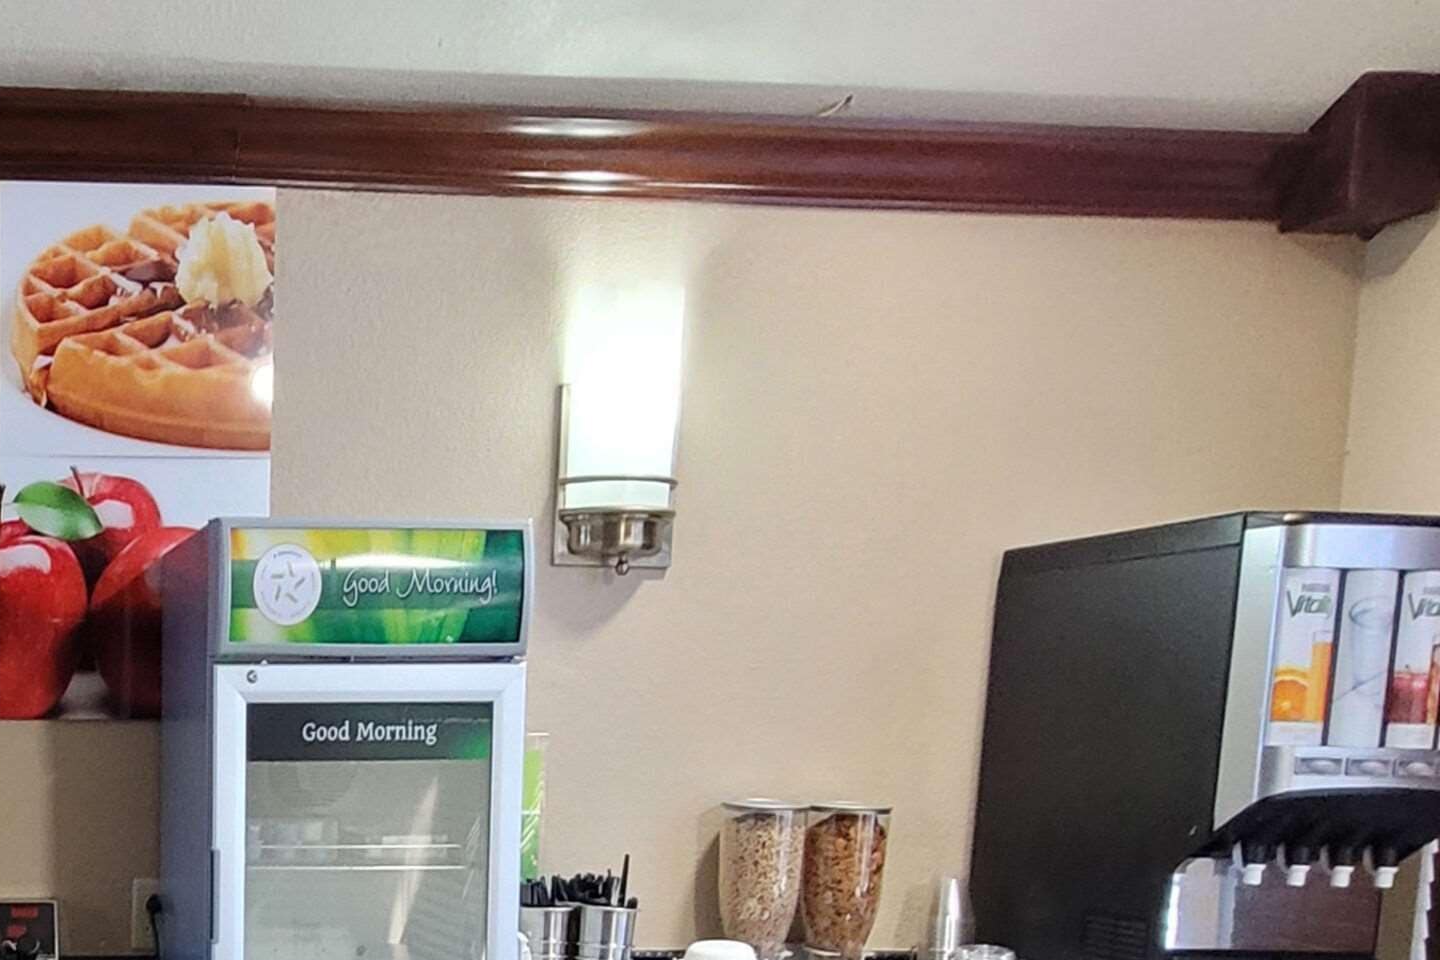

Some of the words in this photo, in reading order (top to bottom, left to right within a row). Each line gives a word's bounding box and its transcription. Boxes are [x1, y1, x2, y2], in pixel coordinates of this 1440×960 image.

[343, 567, 391, 607] Good
[396, 567, 498, 605] Morning!
[302, 719, 350, 742] Good
[355, 719, 438, 746] Morning
